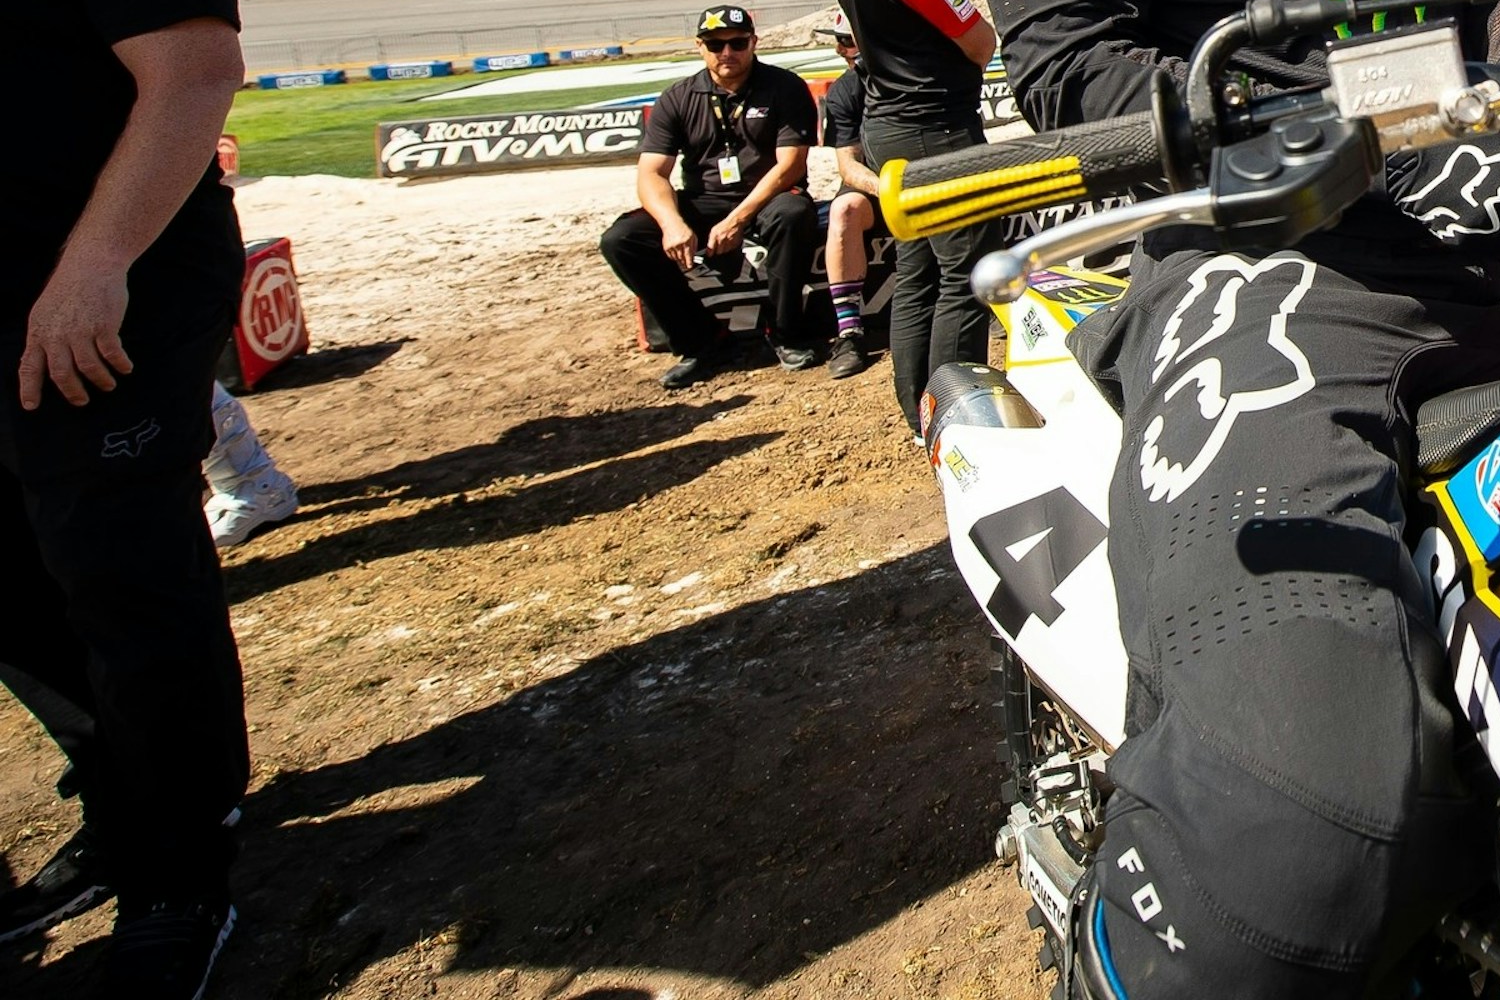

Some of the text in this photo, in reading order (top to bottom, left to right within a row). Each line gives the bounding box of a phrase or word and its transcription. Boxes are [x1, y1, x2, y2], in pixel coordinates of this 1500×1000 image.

[424, 110, 642, 142] ROCKY MOUNTAIN
[966, 484, 1109, 642] 4
[1116, 846, 1187, 953] FOX
